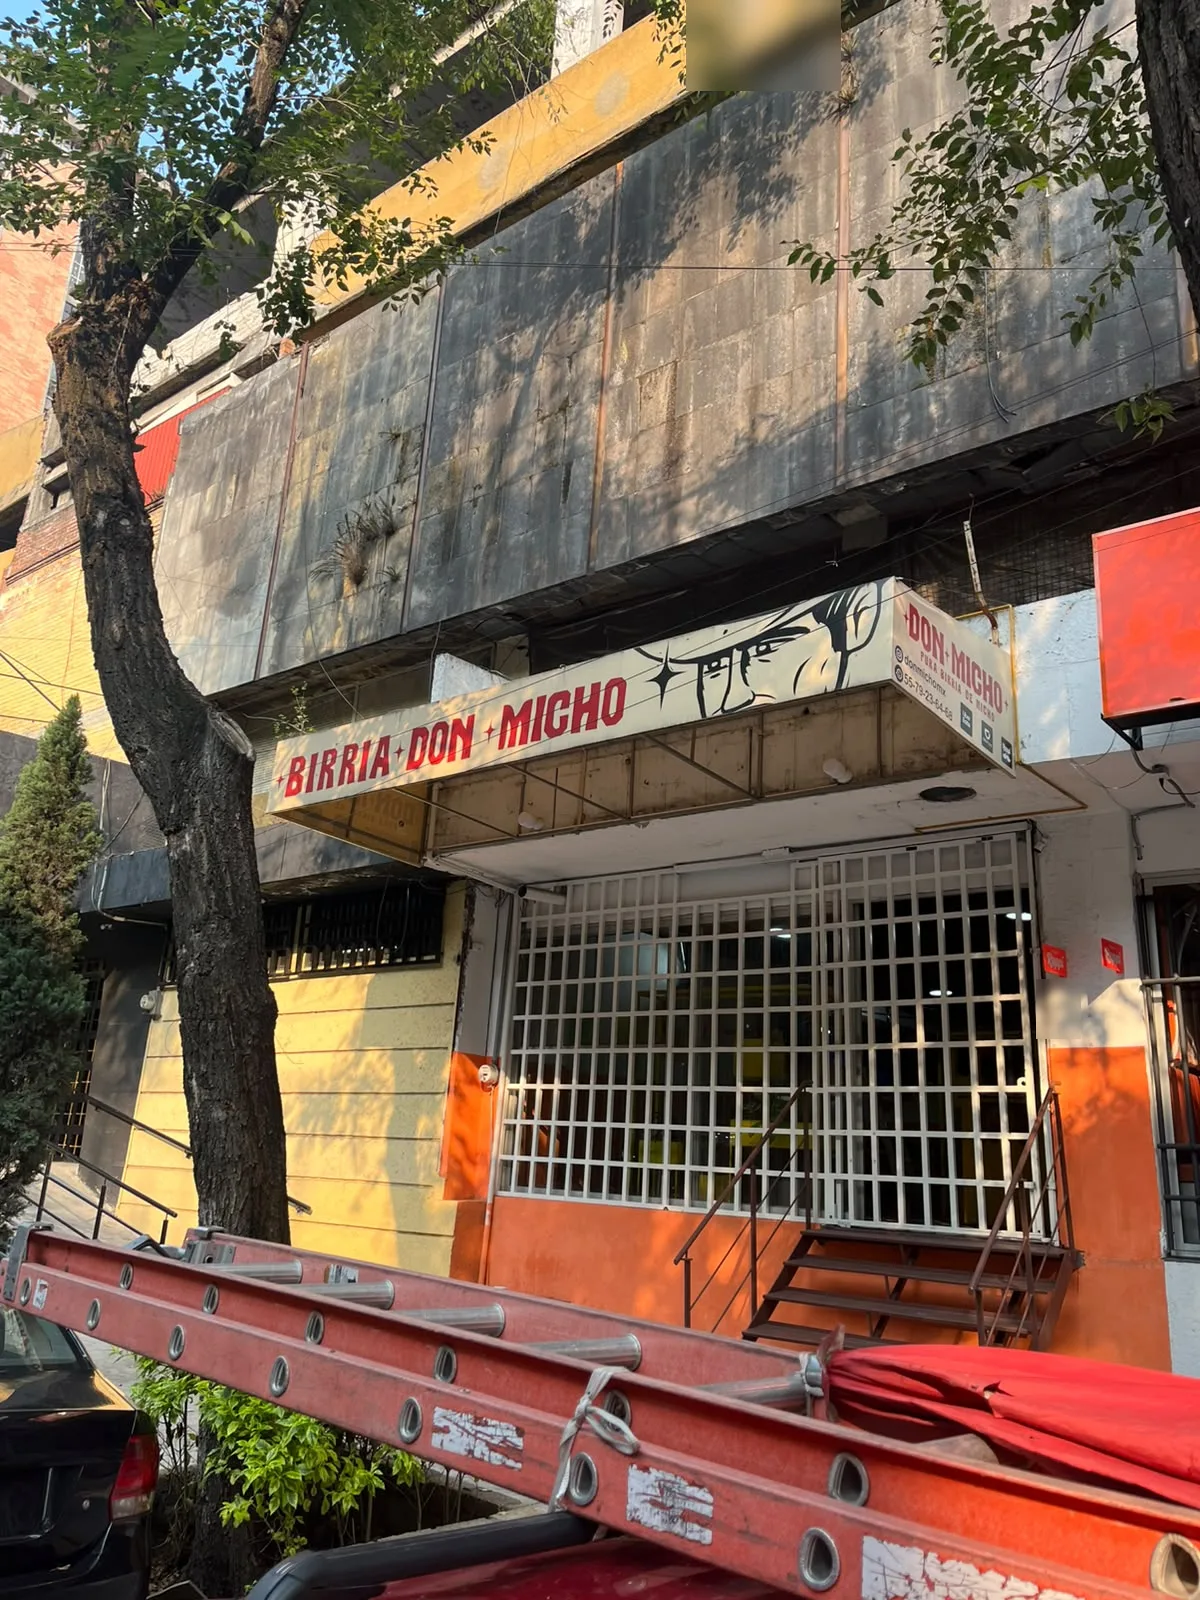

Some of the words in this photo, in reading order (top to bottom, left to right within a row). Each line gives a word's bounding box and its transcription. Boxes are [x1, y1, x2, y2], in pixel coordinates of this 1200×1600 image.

[909, 603, 945, 666] DON
[951, 642, 1003, 714] MICHO
[284, 735, 390, 798] BIRRIA
[406, 715, 476, 771] DON
[498, 677, 627, 750] MICHO
